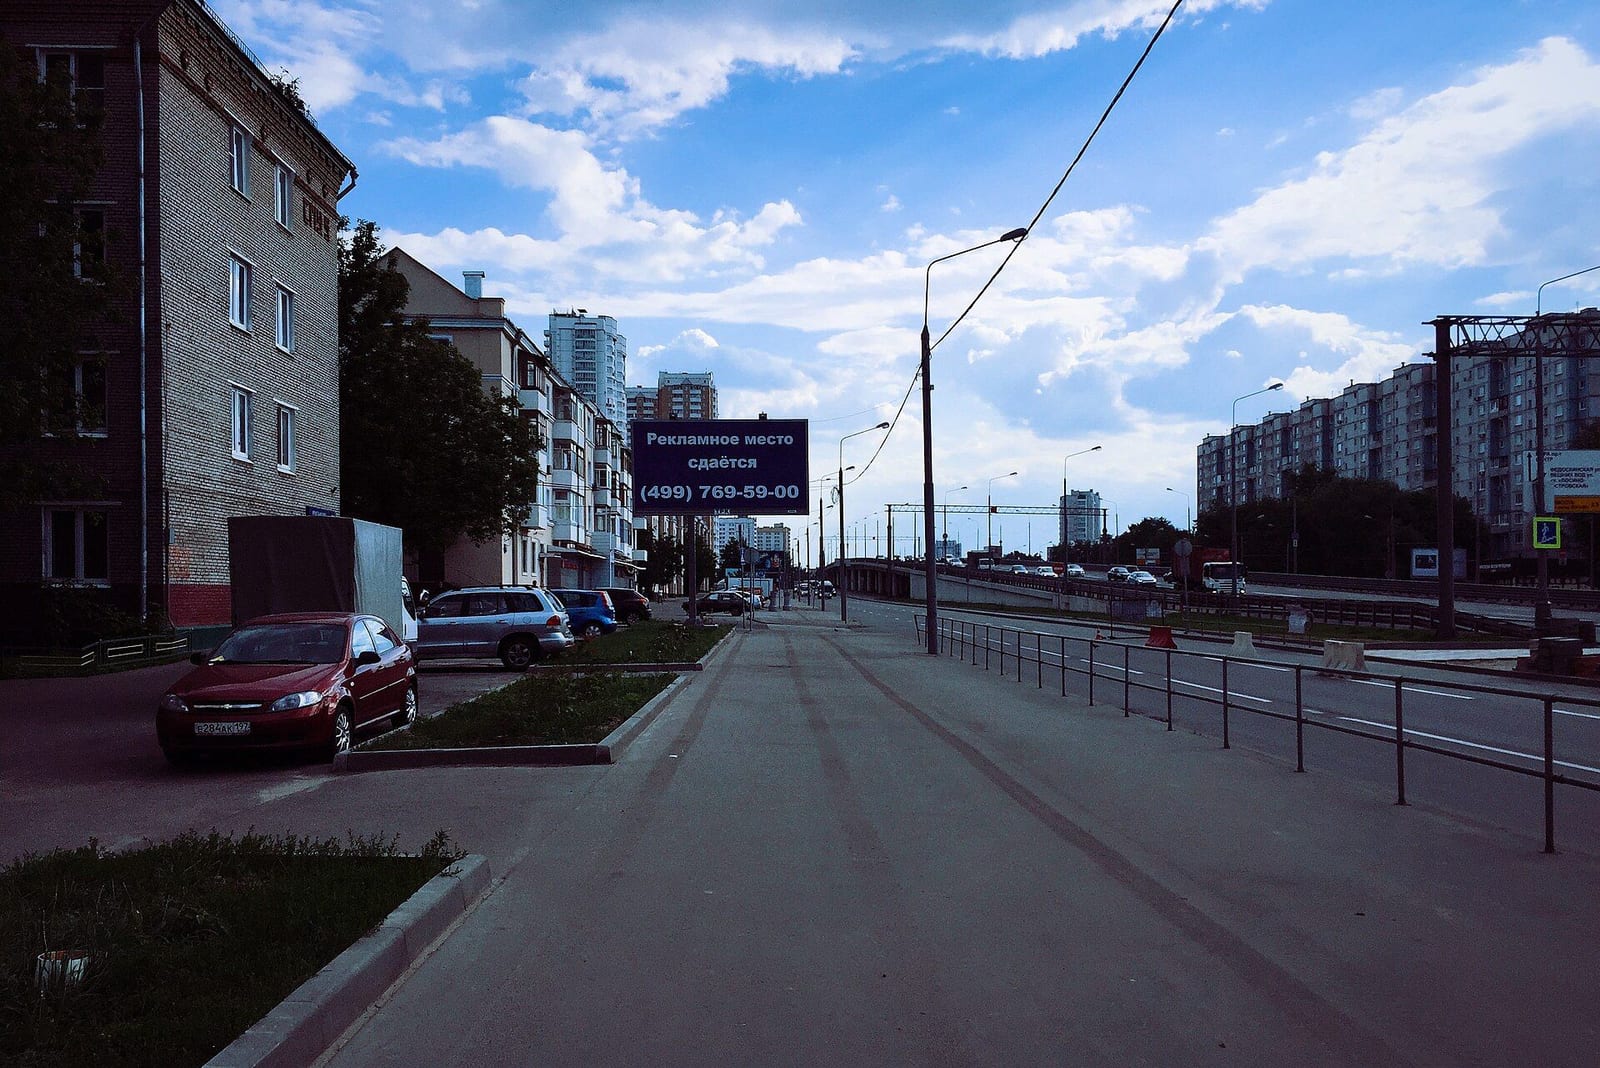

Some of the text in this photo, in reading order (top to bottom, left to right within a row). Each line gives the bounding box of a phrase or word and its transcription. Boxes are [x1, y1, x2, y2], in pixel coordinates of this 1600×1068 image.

[646, 432, 794, 446] Рекламное место
[687, 455, 758, 471] сдаётся
[640, 484, 799, 502] (499) 769-59-00
